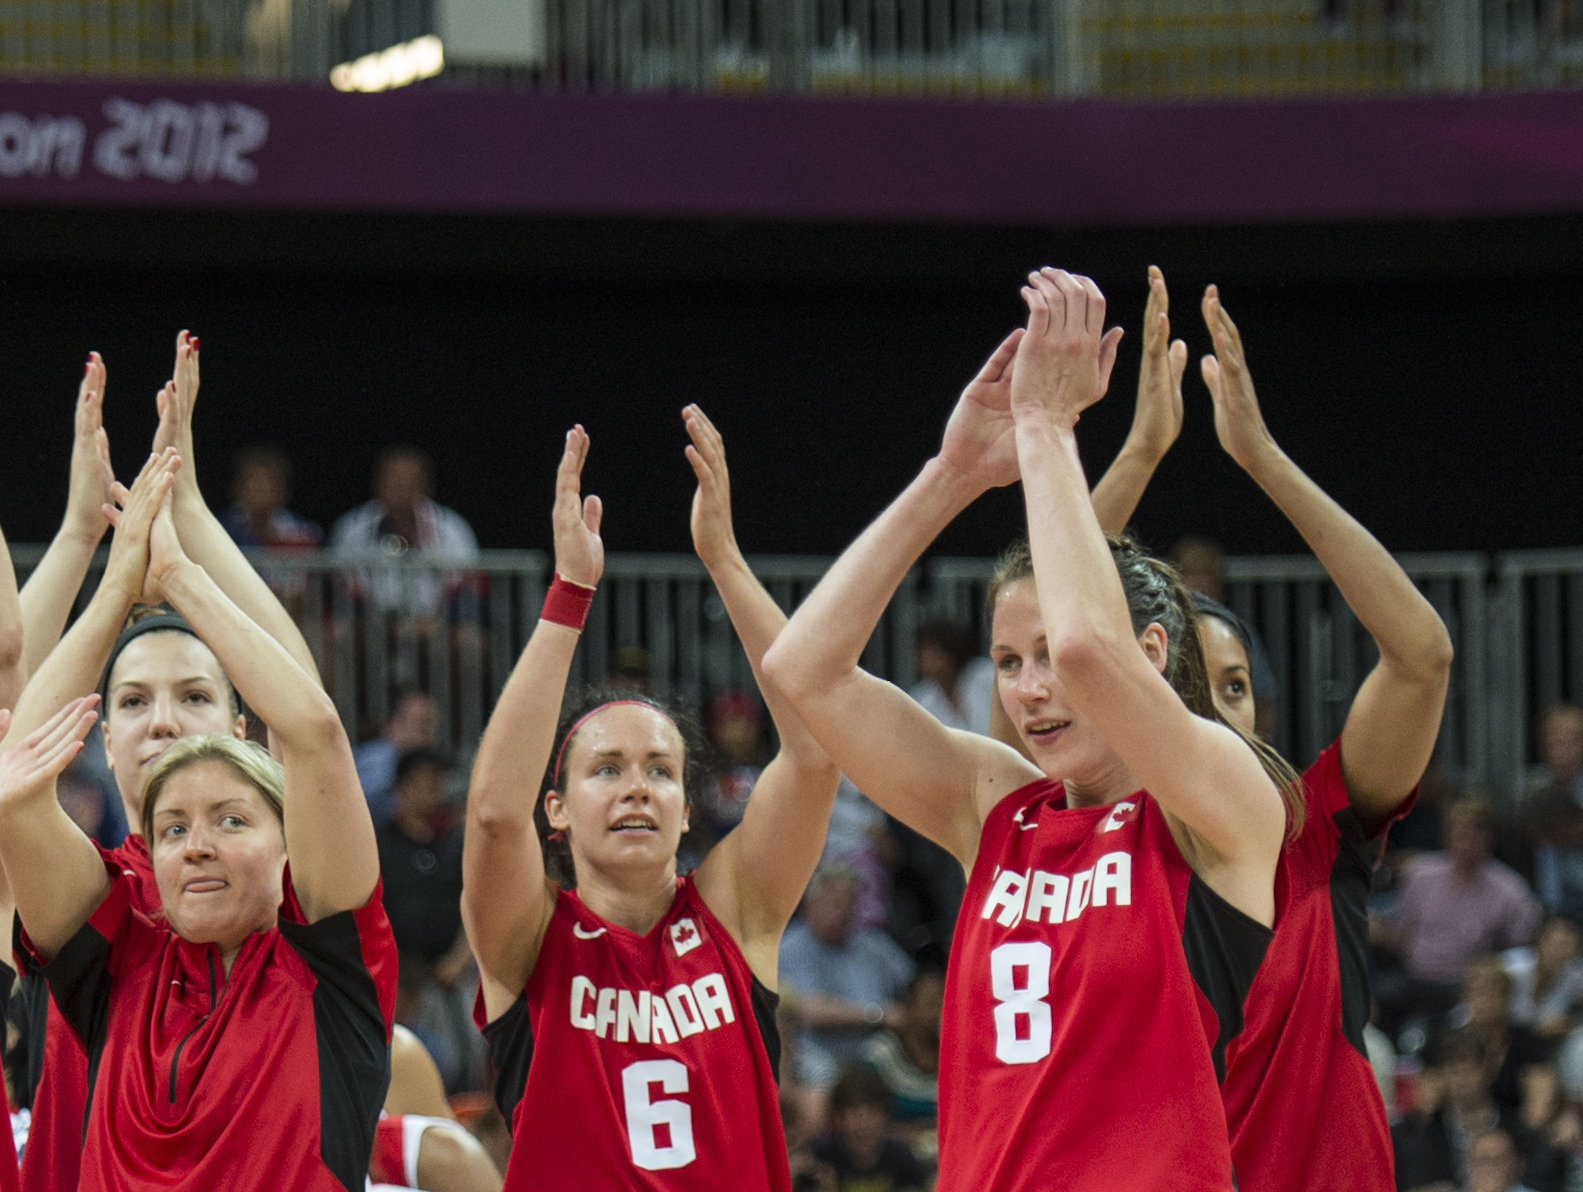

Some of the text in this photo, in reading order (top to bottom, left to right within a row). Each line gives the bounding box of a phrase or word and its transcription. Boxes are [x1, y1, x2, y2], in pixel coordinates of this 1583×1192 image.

[94, 97, 269, 184] 2012
[570, 972, 735, 1044] CANADA
[991, 941, 1053, 1065] 8
[621, 1058, 697, 1171] 6
